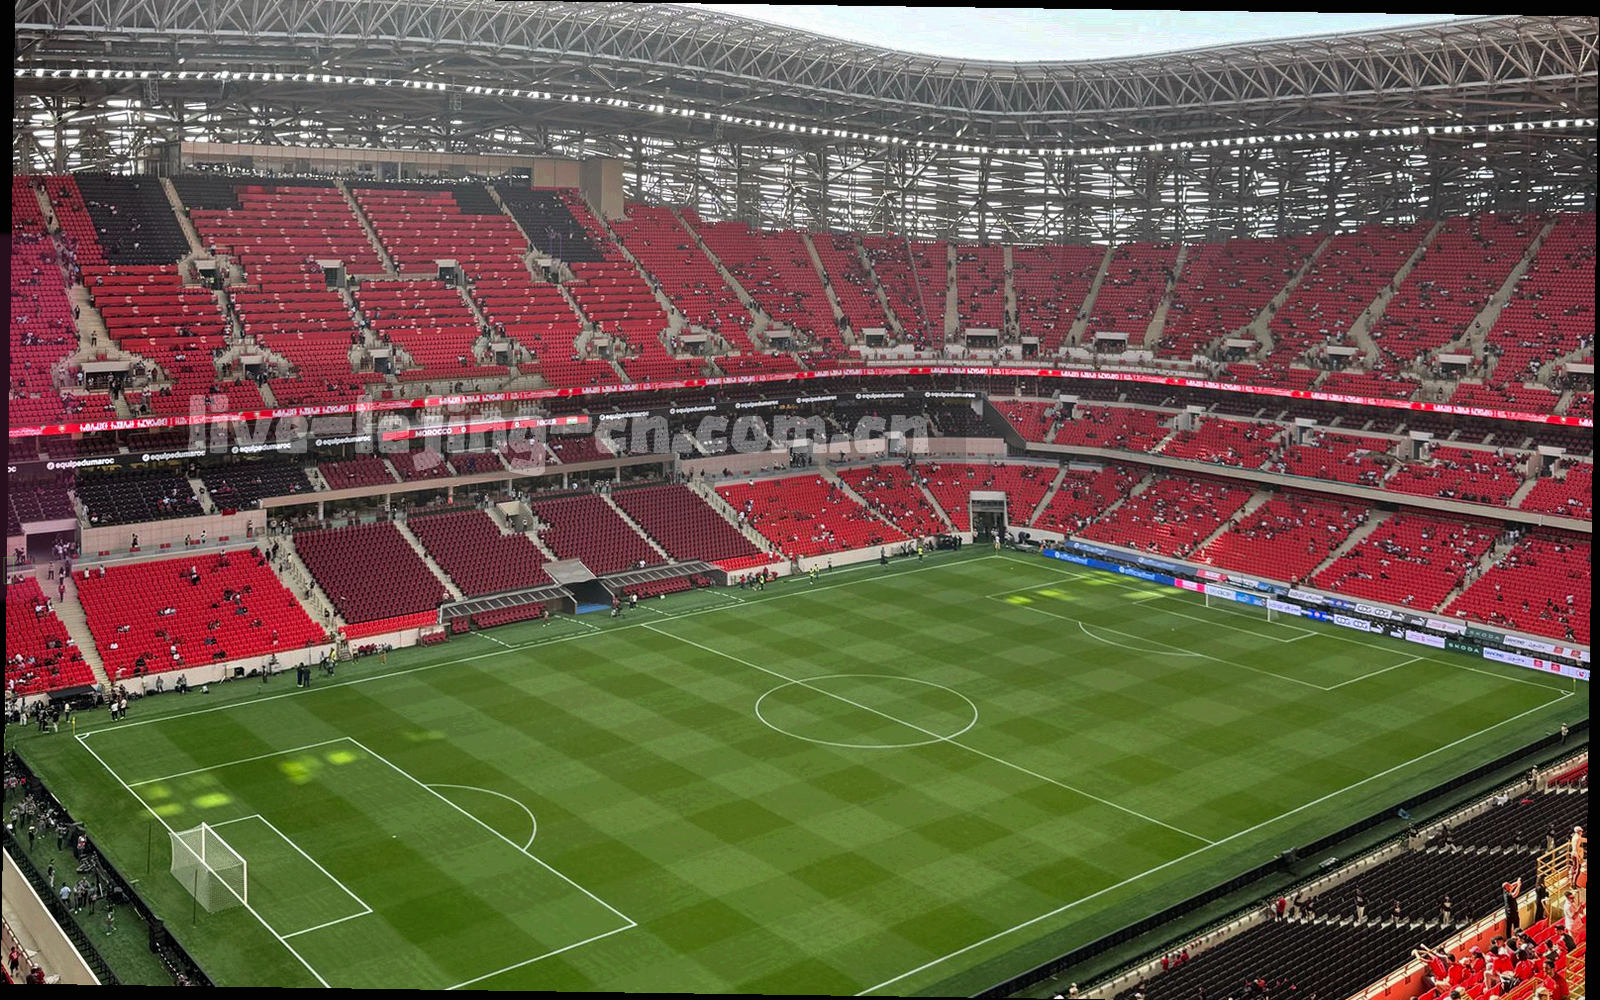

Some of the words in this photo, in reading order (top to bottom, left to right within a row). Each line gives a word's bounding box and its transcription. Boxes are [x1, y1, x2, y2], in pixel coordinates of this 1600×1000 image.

[415, 427, 452, 437] MOROCCO
[239, 442, 291, 453] equipedumaroc
[150, 450, 206, 462] equipedumaroc
[55, 458, 115, 470] equipedumaroc
